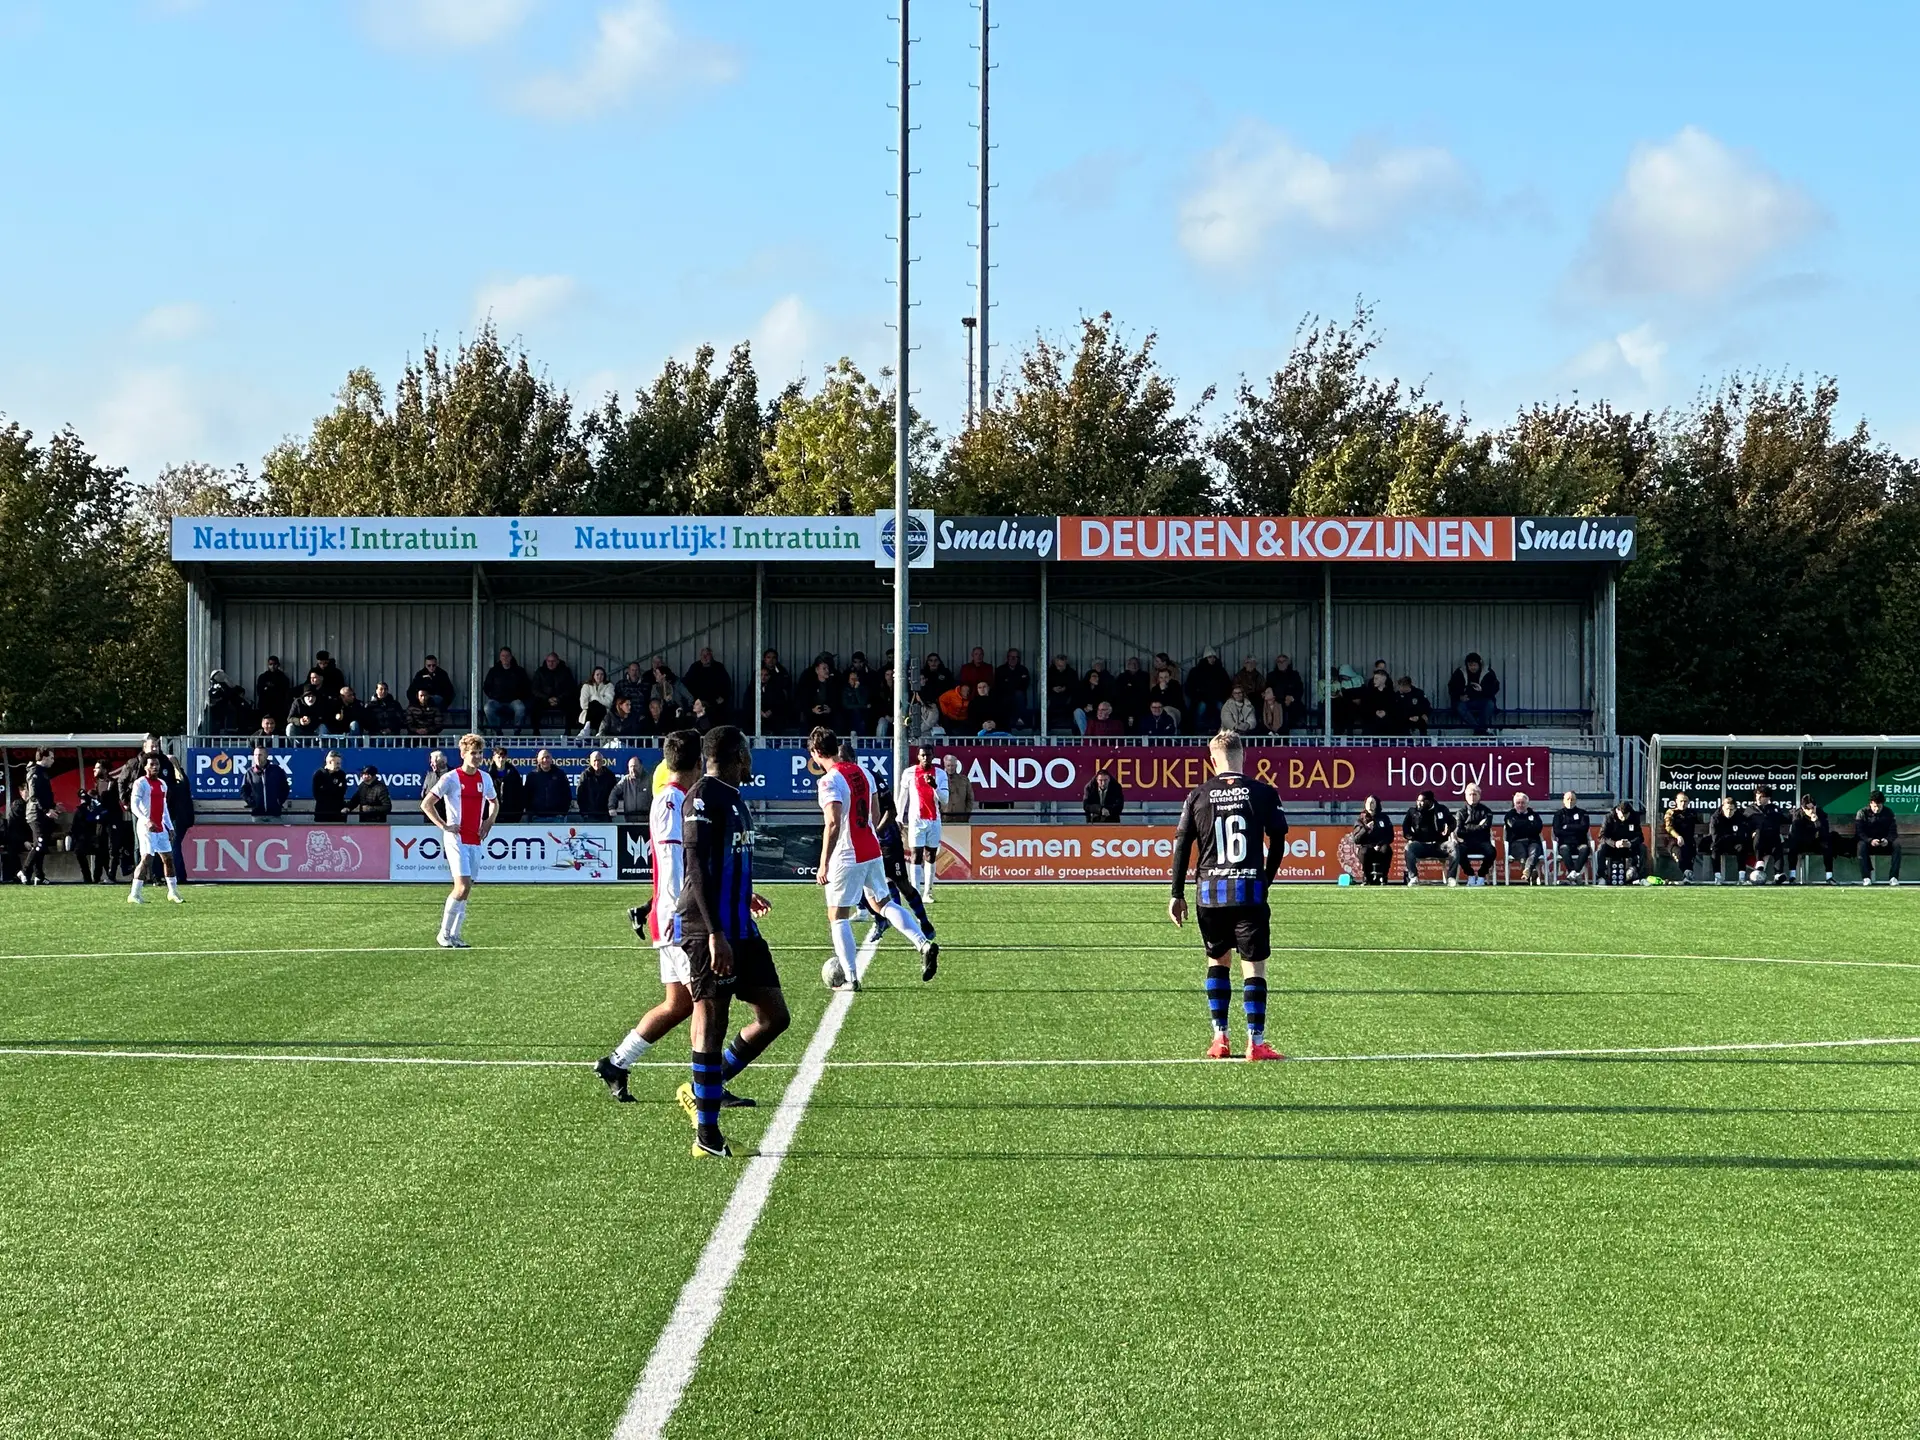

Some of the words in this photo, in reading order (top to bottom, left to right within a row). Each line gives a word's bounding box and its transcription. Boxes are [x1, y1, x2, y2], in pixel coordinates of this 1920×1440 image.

[193, 526, 346, 556] Natuurlijk!
[350, 527, 477, 549] Intratuin
[575, 526, 726, 556] Natuurlijk!
[732, 526, 861, 549] Intratuin
[937, 519, 1054, 557] Smaling
[1518, 520, 1634, 557] Smaling
[196, 754, 293, 774] PORX
[792, 755, 889, 775] POEX
[1256, 759, 1278, 788] &
[1290, 759, 1355, 788] BAD
[1387, 753, 1535, 794] Hoogvliet
[1660, 781, 1692, 792] Bekijk
[1780, 783, 1797, 792] op:
[1670, 771, 1694, 780] Voor
[1697, 771, 1722, 782] jouw
[1728, 771, 1765, 780] nieuwe
[1768, 771, 1795, 780] baan
[1801, 772, 1816, 780] als
[1819, 771, 1868, 782] operator!
[1210, 787, 1249, 797] GRANDO
[1877, 784, 1920, 794] TERMI
[979, 831, 1081, 858] Samen
[1091, 838, 1178, 858] score
[1214, 815, 1247, 864] 16
[193, 838, 292, 872] ING
[396, 863, 416, 871] Scoor
[418, 863, 436, 872] jouw
[497, 863, 506, 871] de
[508, 863, 528, 871] beste
[979, 866, 1001, 878] Kijk
[1004, 868, 1031, 876] voor
[1034, 866, 1054, 876] alle
[1058, 866, 1163, 878] groepsactiviteiten
